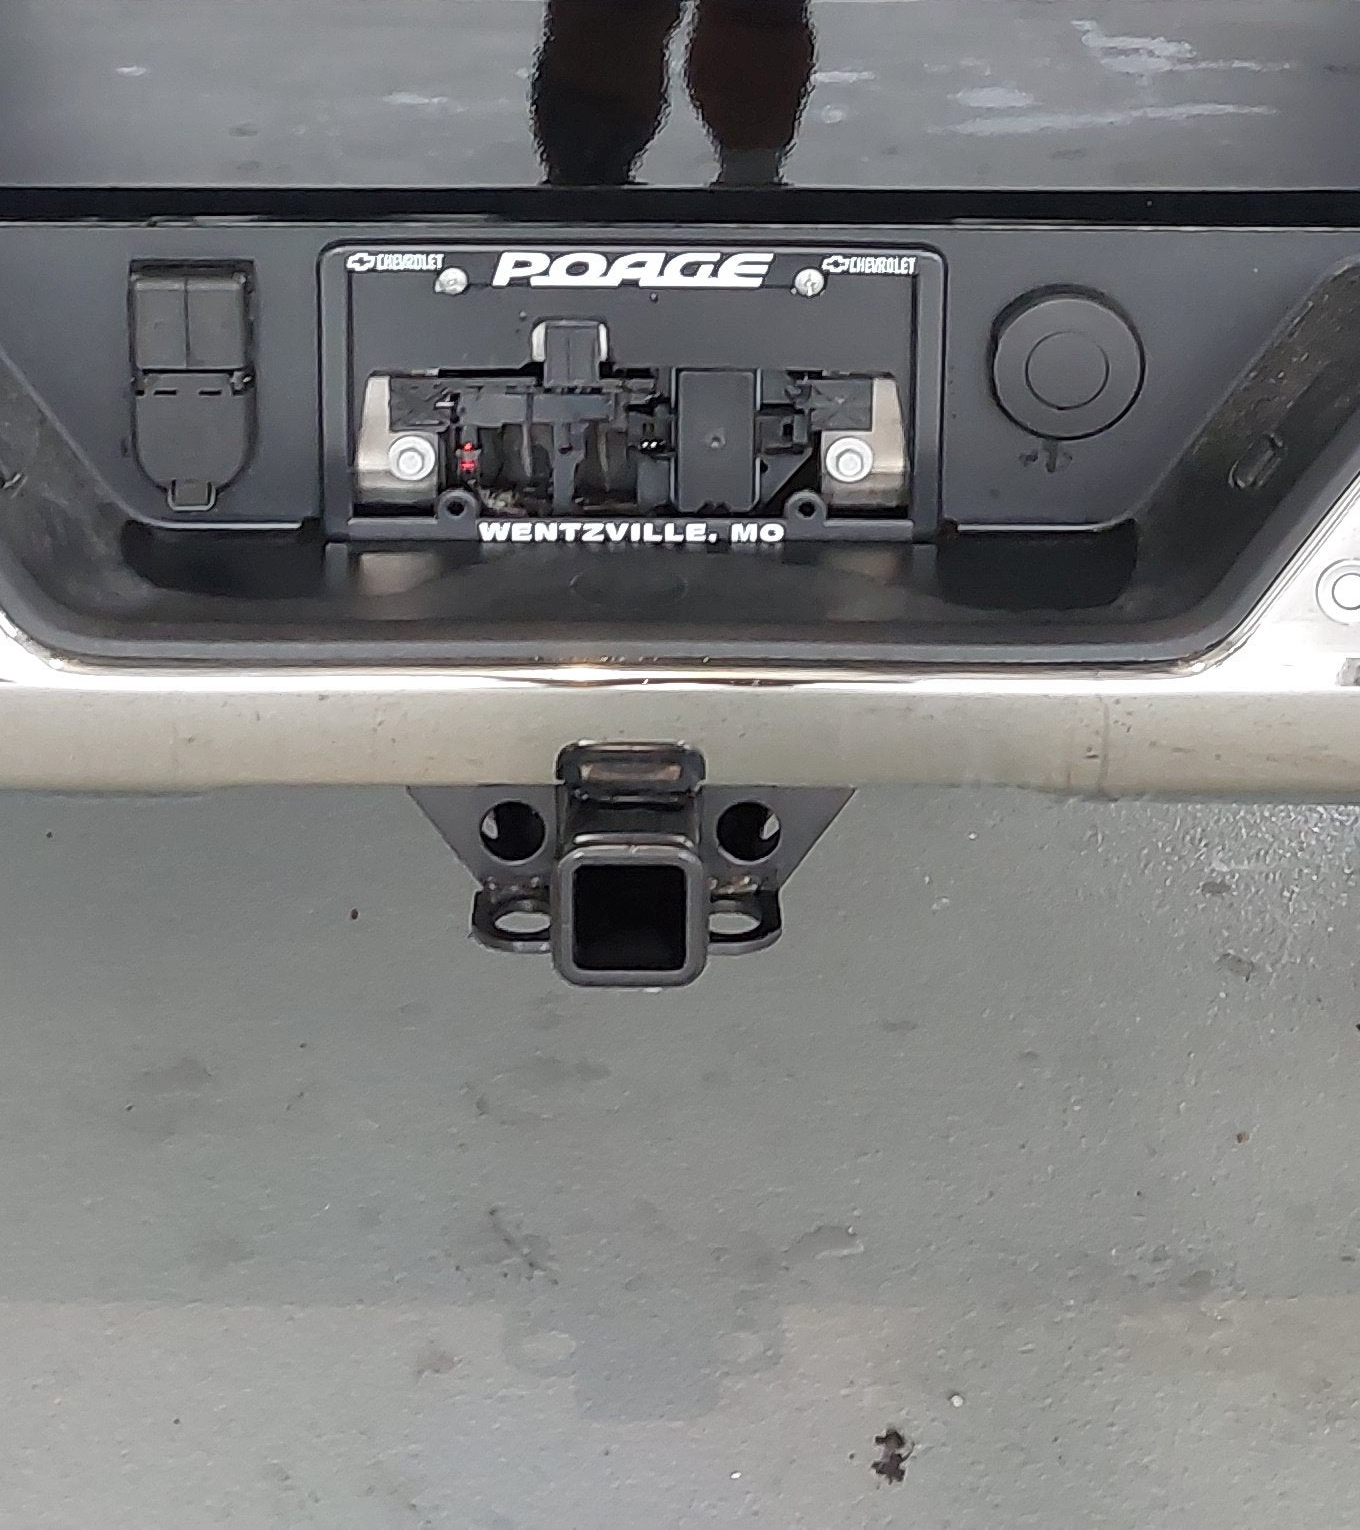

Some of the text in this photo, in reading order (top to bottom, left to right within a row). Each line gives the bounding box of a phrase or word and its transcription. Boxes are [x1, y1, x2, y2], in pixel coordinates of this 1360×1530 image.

[375, 253, 444, 271] CHEVROLET
[491, 252, 774, 287] POAGE
[848, 255, 917, 274] CHEVROLET
[478, 521, 786, 543] WENTZVILLE, MO
